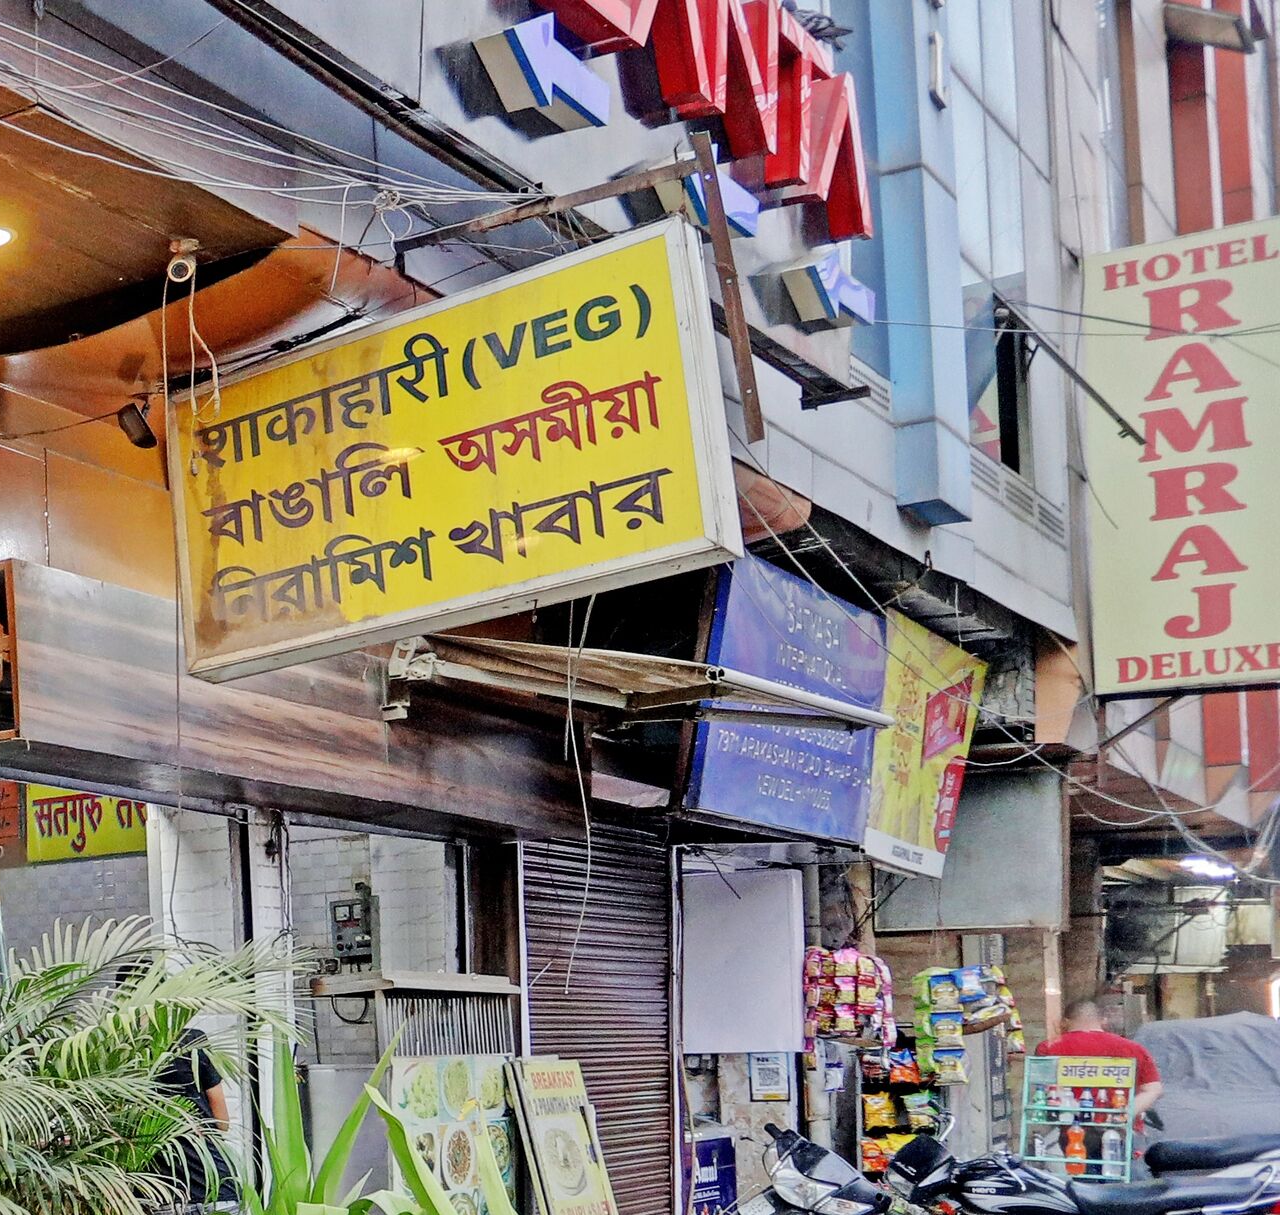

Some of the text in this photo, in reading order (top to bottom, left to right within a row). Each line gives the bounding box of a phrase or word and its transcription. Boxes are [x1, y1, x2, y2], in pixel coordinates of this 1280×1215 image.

[1102, 234, 1280, 292] HOTEL
[195, 284, 653, 469] शाकाहारी (VEG)
[201, 370, 663, 547] বাঙালি অসমীয়া
[447, 467, 673, 564] খাবার
[1138, 278, 1253, 641] RAMRAJ
[531, 1070, 577, 1090] BREAKFAST
